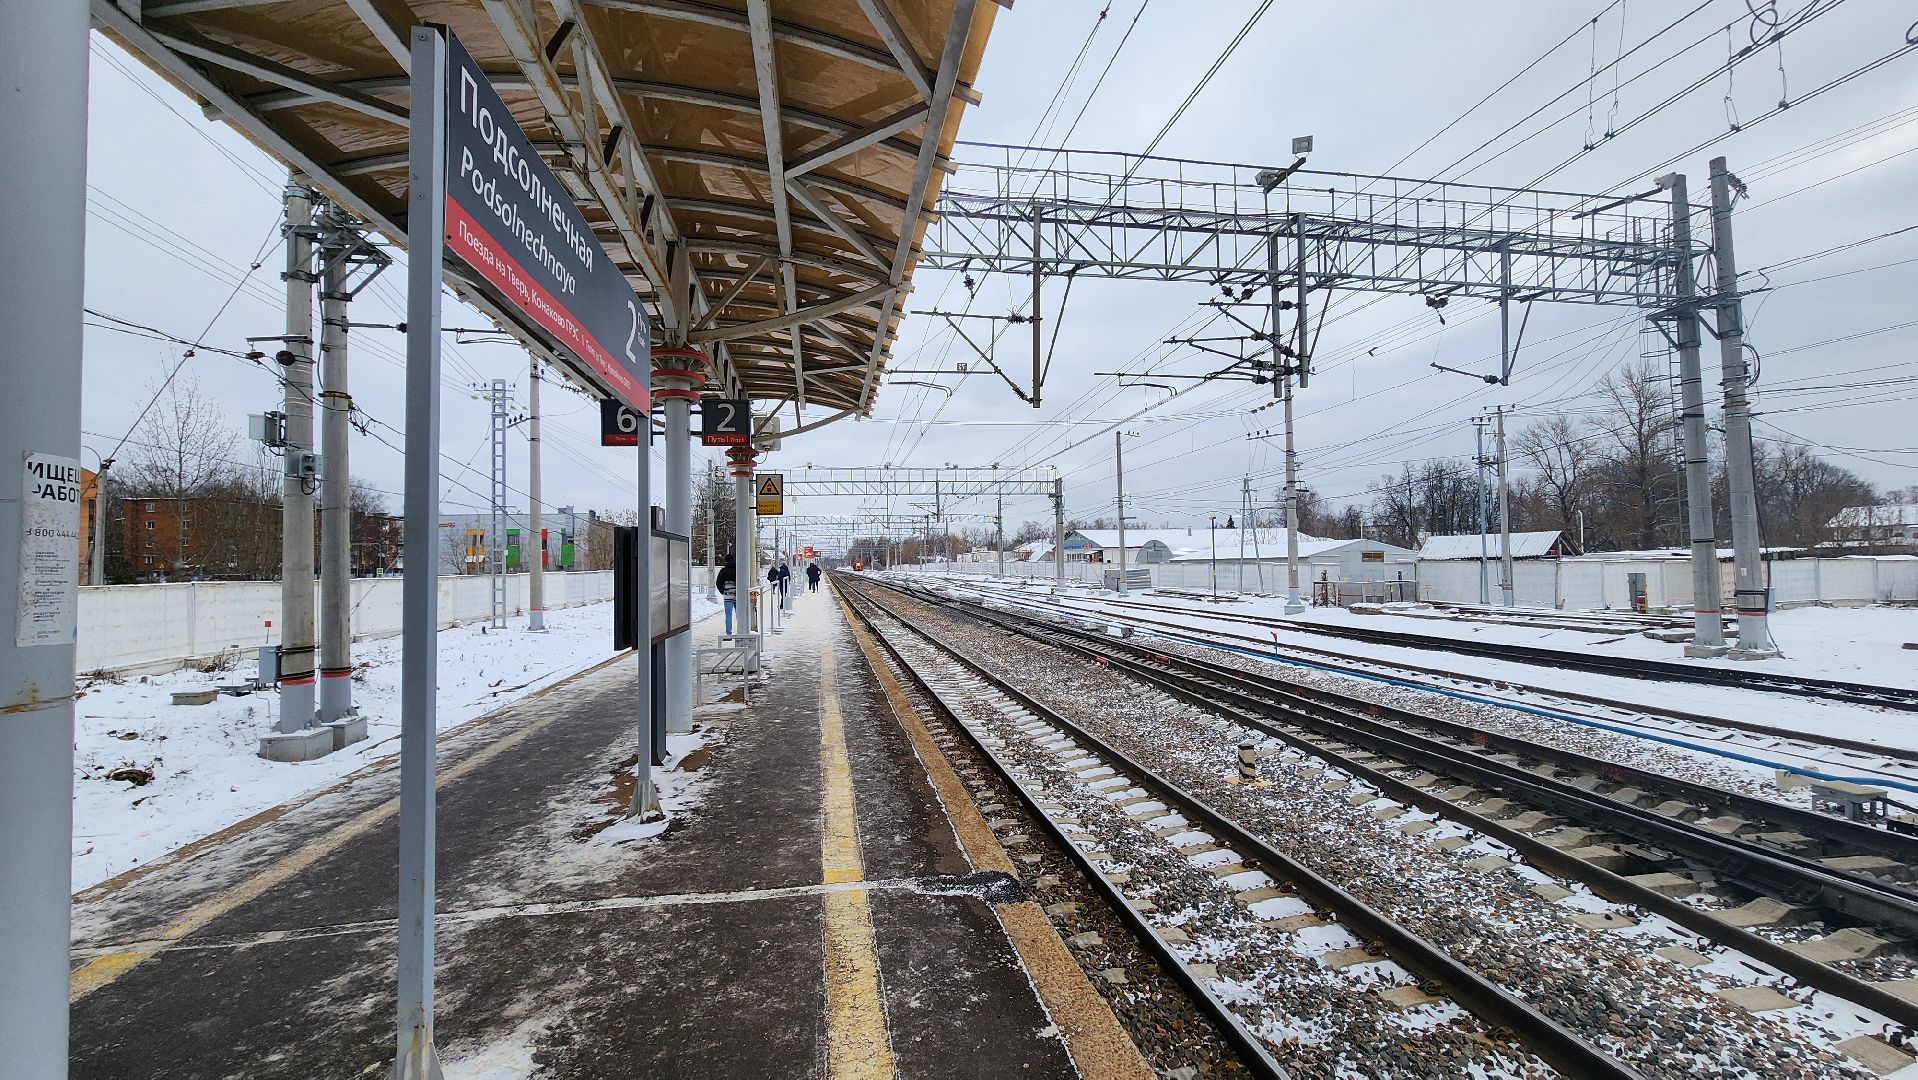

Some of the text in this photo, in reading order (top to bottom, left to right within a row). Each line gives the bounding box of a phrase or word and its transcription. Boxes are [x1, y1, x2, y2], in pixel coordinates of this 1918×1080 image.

[461, 65, 593, 273] Подсолнечная
[461, 146, 576, 296] Podsolnechnaya
[459, 220, 579, 342] Поезда на Тверь, Конаково ГРЭС
[625, 300, 637, 364] 2
[616, 405, 637, 433] 6
[707, 436, 725, 444] Путь
[717, 403, 736, 432] 2
